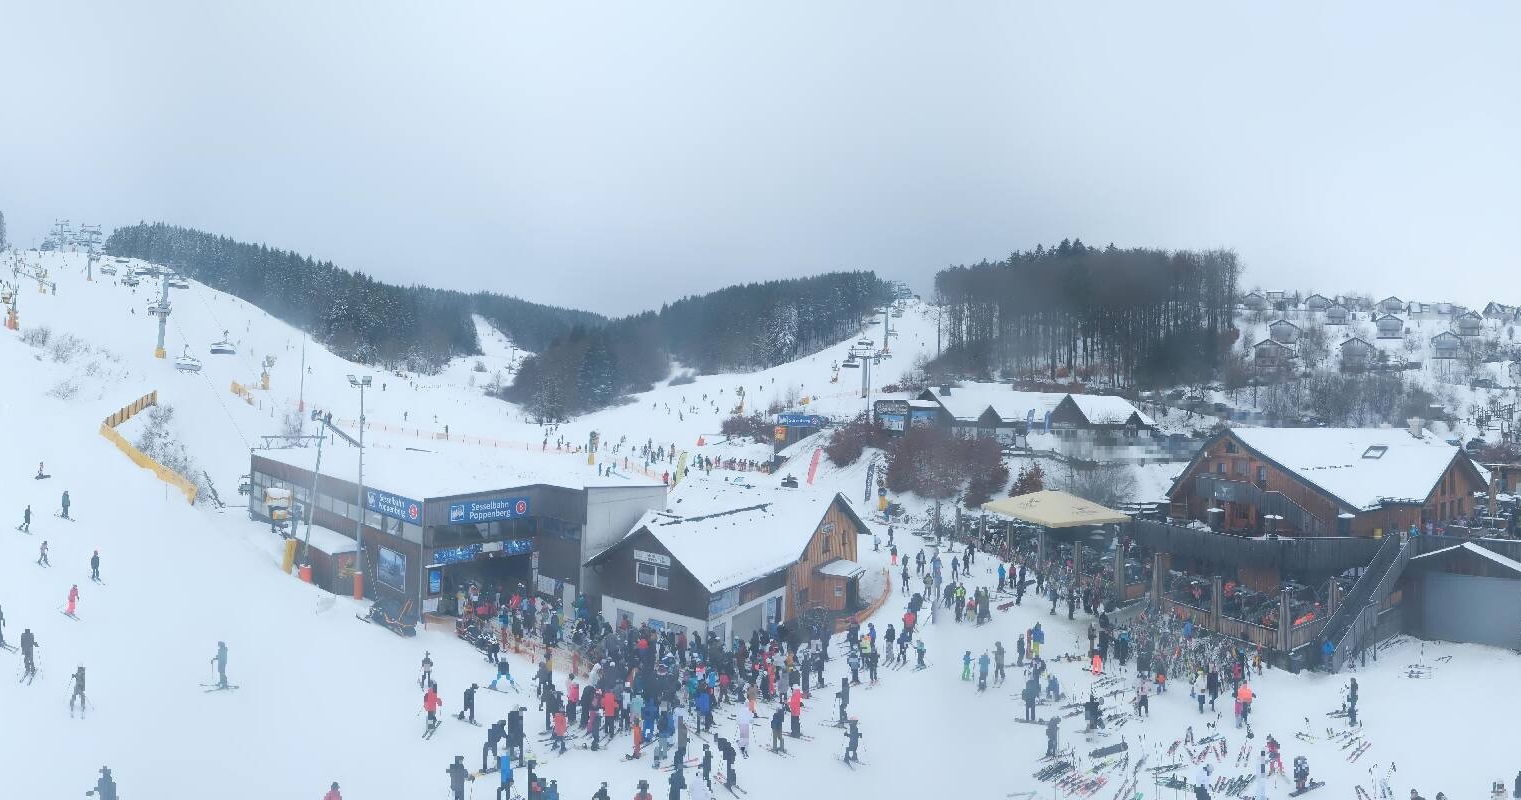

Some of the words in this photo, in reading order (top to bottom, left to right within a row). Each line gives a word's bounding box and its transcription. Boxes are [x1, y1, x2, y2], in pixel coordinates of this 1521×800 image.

[379, 493, 405, 508] Sesselbahn
[471, 500, 509, 511] Sesselbahn
[469, 509, 511, 520] Poppenberg
